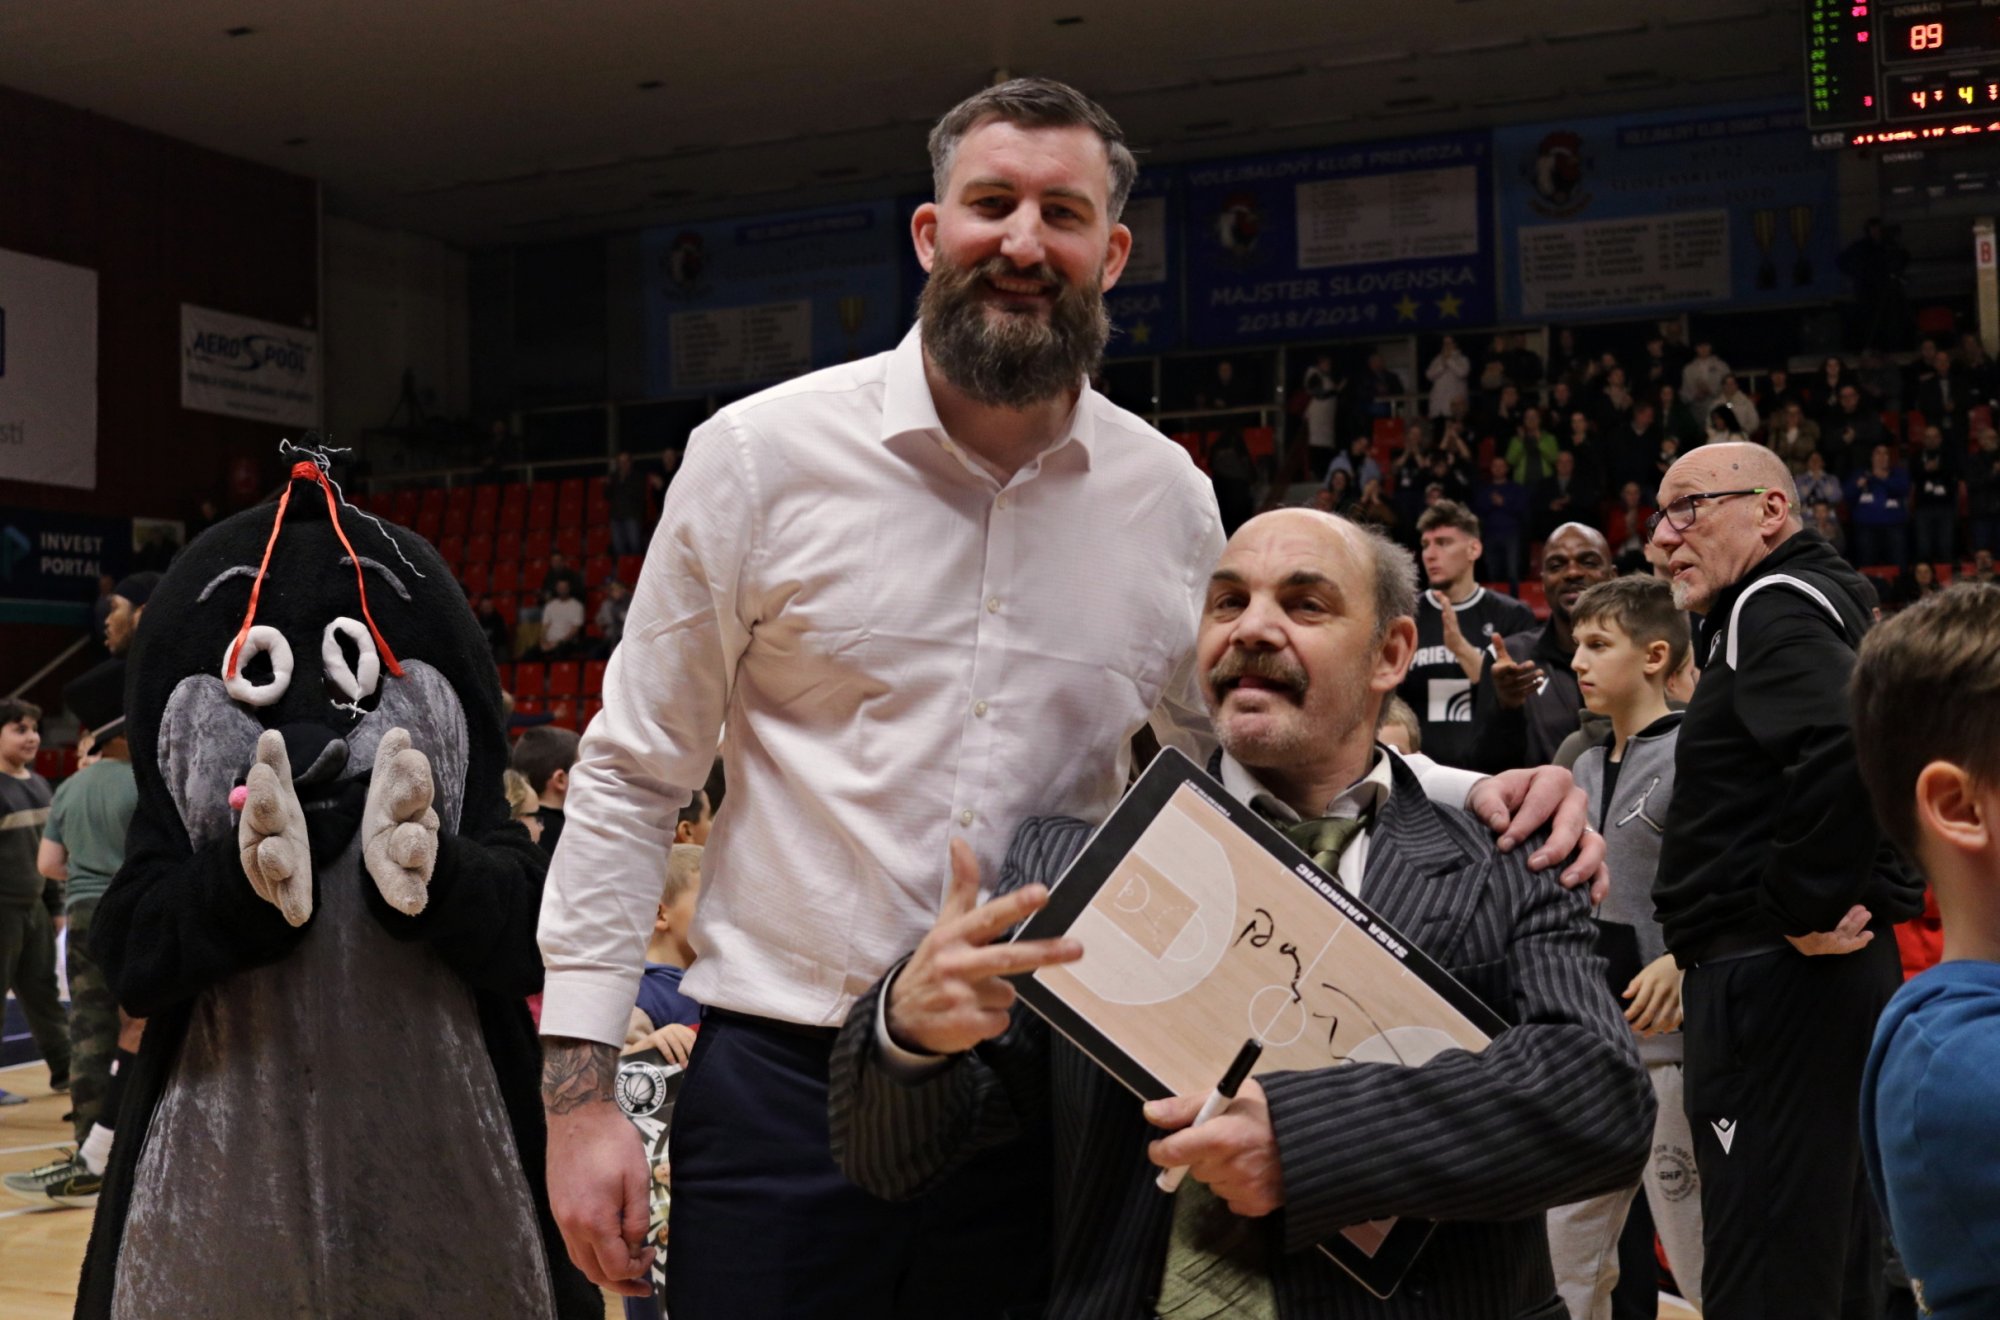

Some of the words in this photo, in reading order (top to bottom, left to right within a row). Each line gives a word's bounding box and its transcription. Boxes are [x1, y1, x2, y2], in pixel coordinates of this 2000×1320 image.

[1910, 23, 1942, 50] 89
[1911, 90, 1926, 109] 4
[1958, 86, 1973, 104] 4
[1317, 152, 1363, 172] KLUB
[1369, 145, 1464, 167] PRIEVIDZA
[1210, 279, 1320, 307] MAJSTER
[1329, 265, 1476, 298] SLOVENSKA
[1236, 303, 1378, 333] 2018/2019
[41, 531, 104, 555] INVEST
[1296, 863, 1369, 922] JANKOVIC
[1368, 923, 1409, 959] SASA
